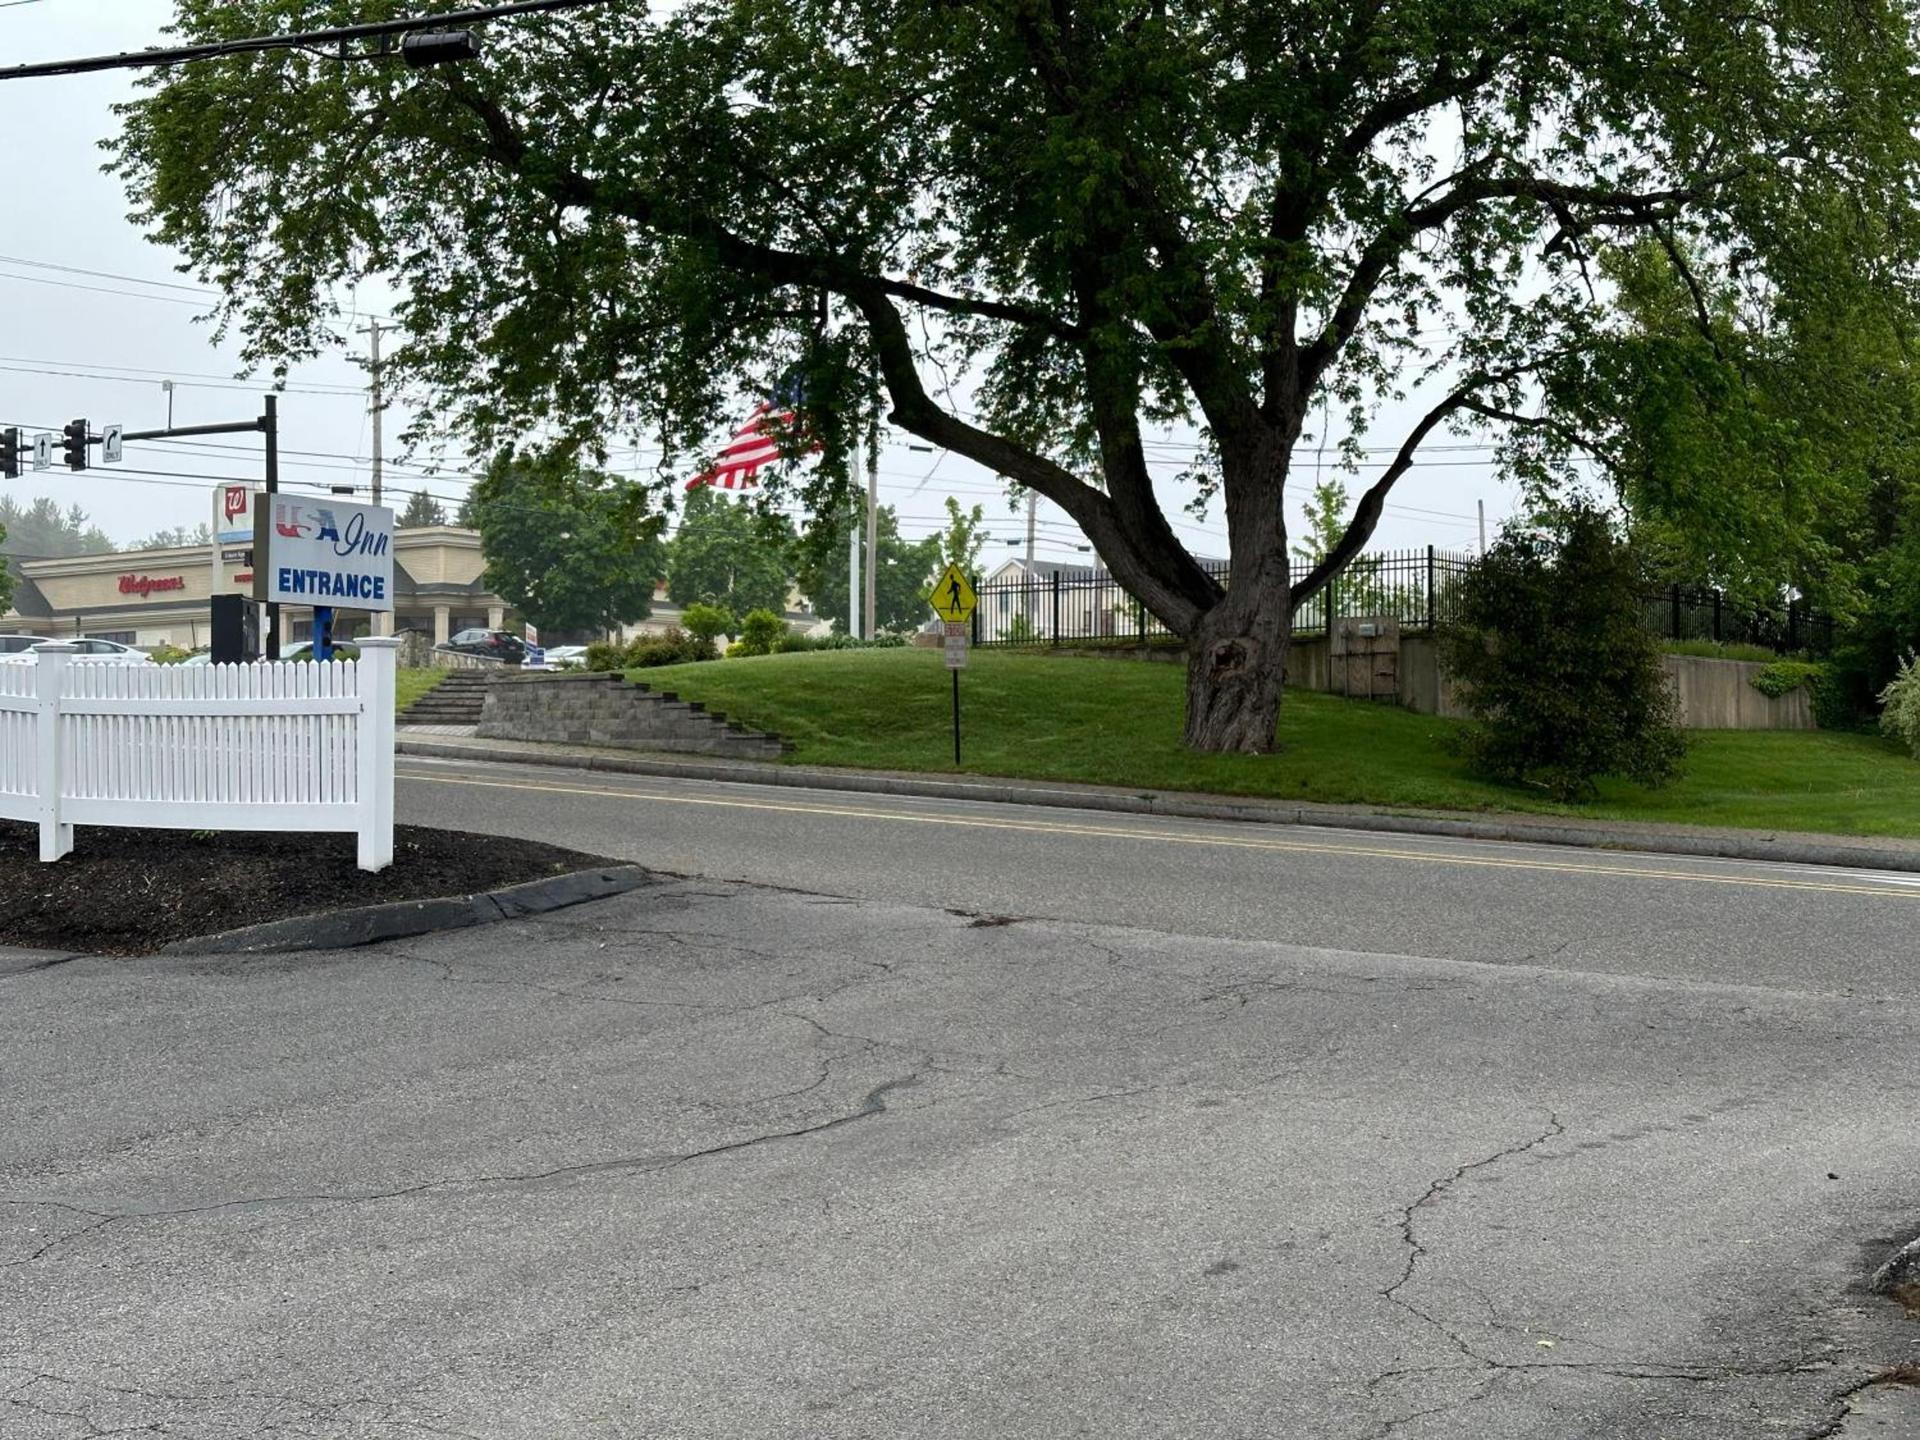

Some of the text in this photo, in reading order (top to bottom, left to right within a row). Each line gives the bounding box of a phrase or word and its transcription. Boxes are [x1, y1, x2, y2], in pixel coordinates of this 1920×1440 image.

[276, 504, 388, 556] USA Inn
[119, 575, 184, 598] Walgreens
[279, 568, 384, 599] ENTRANCE
